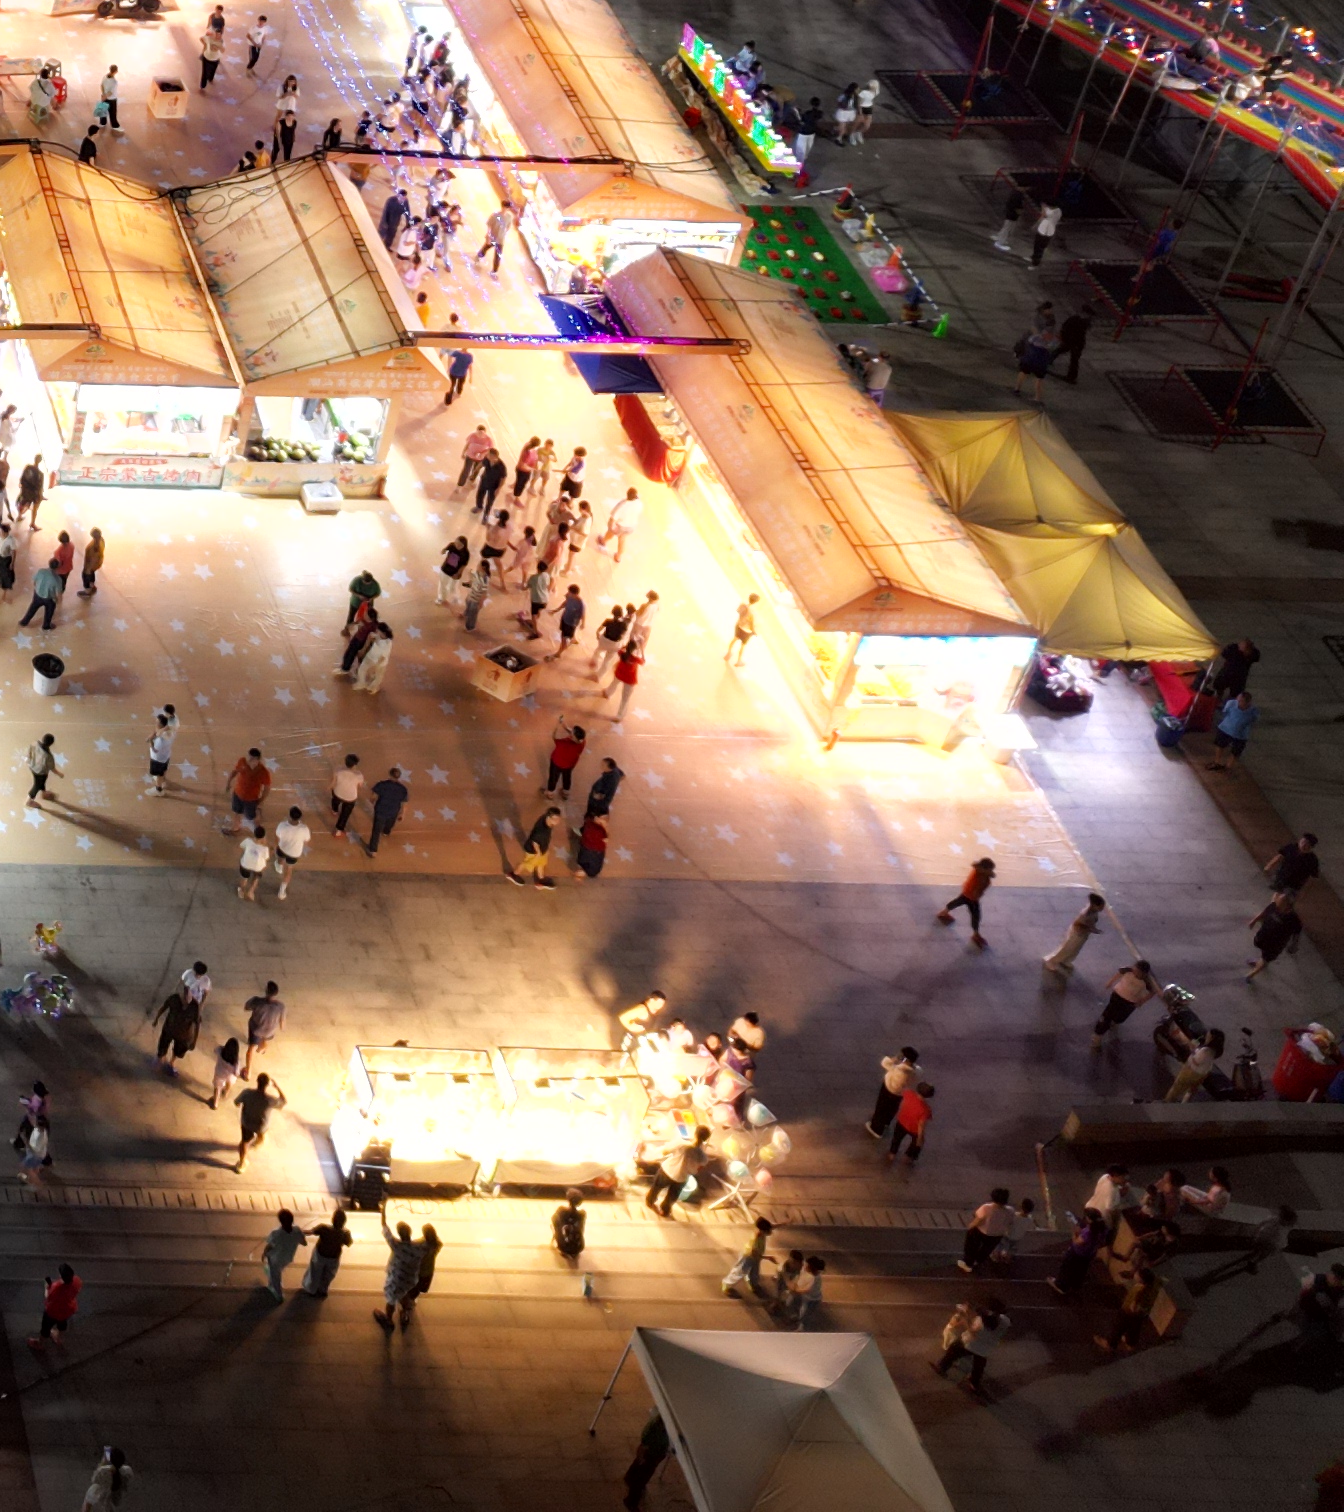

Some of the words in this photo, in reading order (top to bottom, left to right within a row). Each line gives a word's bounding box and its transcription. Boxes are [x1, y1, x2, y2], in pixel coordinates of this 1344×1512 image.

[77, 466, 201, 483] 正宗蒙古烤肉
